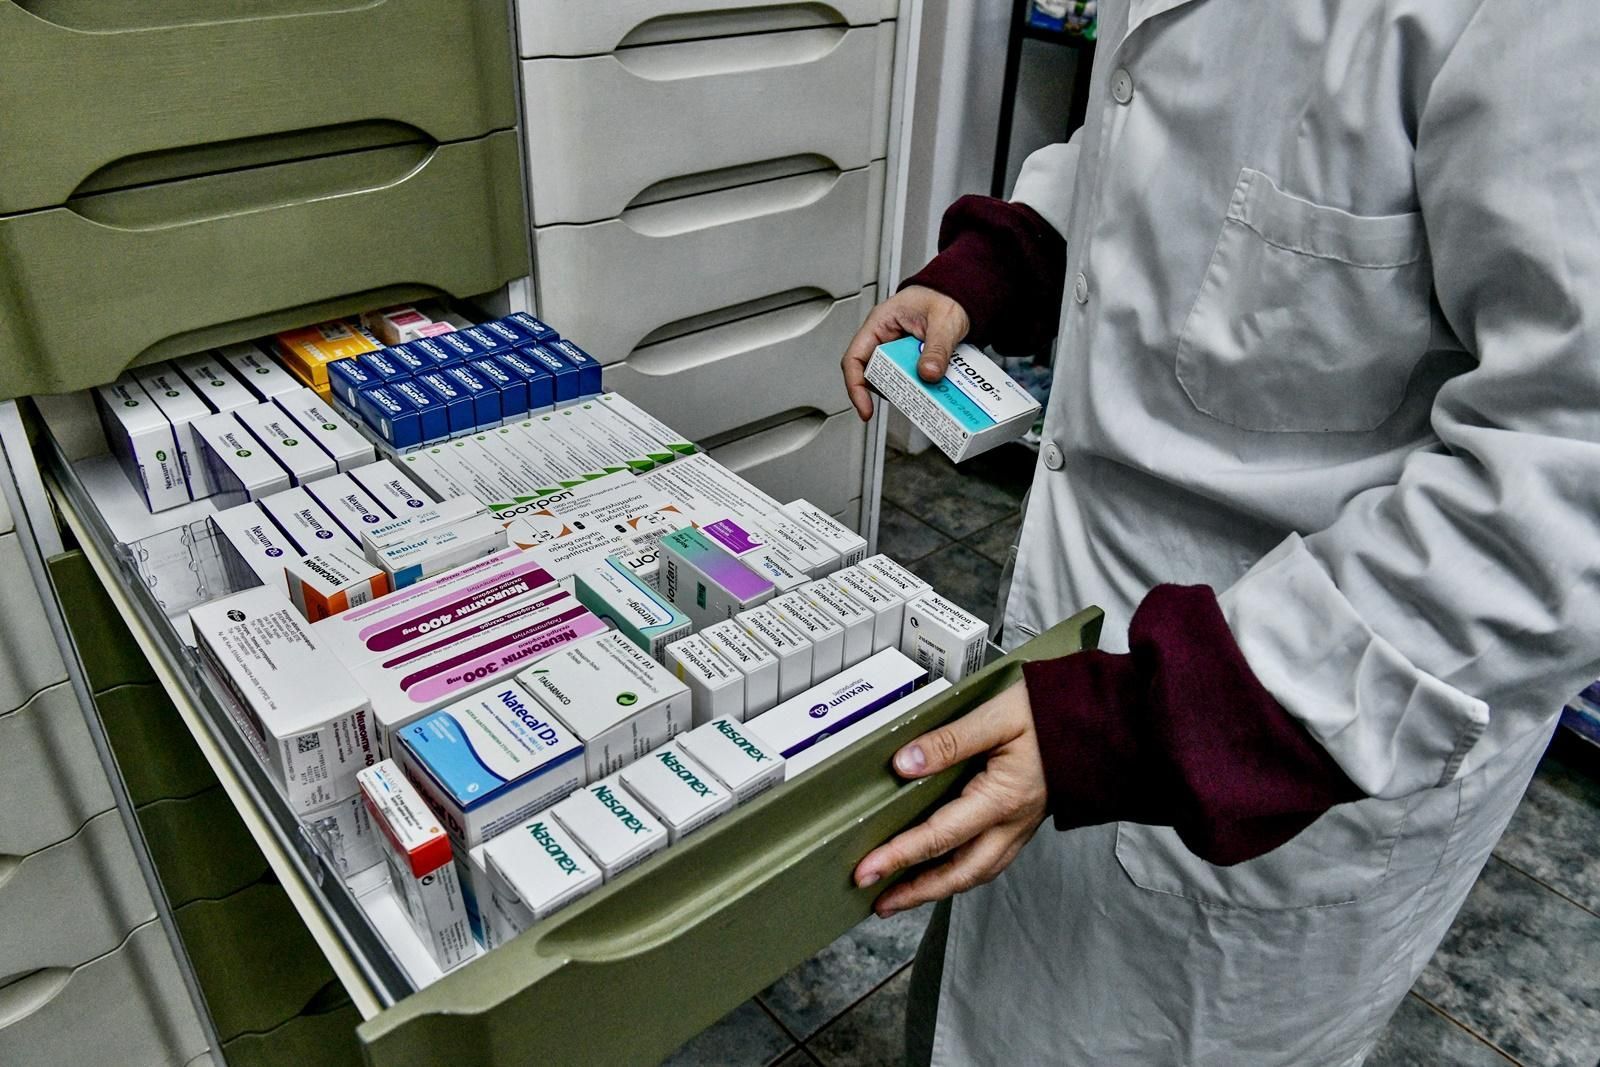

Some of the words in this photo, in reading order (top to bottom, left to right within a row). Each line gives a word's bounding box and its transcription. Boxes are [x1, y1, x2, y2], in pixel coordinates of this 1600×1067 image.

[951, 352, 994, 392] itrong
[309, 408, 328, 423] Nexium
[225, 433, 243, 449] Nexium
[271, 422, 289, 439] Nexium
[161, 463, 172, 489] Nexium
[390, 480, 413, 500] Nexium
[346, 494, 368, 515] Nexium
[578, 511, 589, 519] 30
[300, 509, 323, 531] Nexium
[371, 518, 412, 535] Nebicur
[251, 525, 272, 548] Nexium
[386, 538, 429, 557] Nebicur
[304, 559, 343, 586] NEOCARDON
[763, 562, 772, 570] 50
[770, 567, 782, 577] mg
[764, 555, 794, 579] Normolose
[874, 563, 908, 590] Neurobion
[844, 575, 879, 603] Neurobion
[630, 601, 657, 626] Nitrong
[813, 589, 848, 617] Neurobion
[931, 596, 972, 625] Neurobion
[783, 603, 816, 631] Neurobion
[751, 617, 785, 647] Neurobion
[610, 634, 645, 662] NATECAL
[716, 632, 750, 662] Neurobion
[683, 646, 714, 680] Neurobion
[538, 675, 572, 706] ITALFARMACO
[829, 682, 874, 708] Nexium
[497, 689, 546, 731] Natecal
[540, 728, 560, 747] D3
[712, 720, 768, 762] Nasonex
[656, 751, 712, 796] Nasonex
[591, 785, 647, 834] Nasonex
[527, 822, 581, 876] Nasonex
